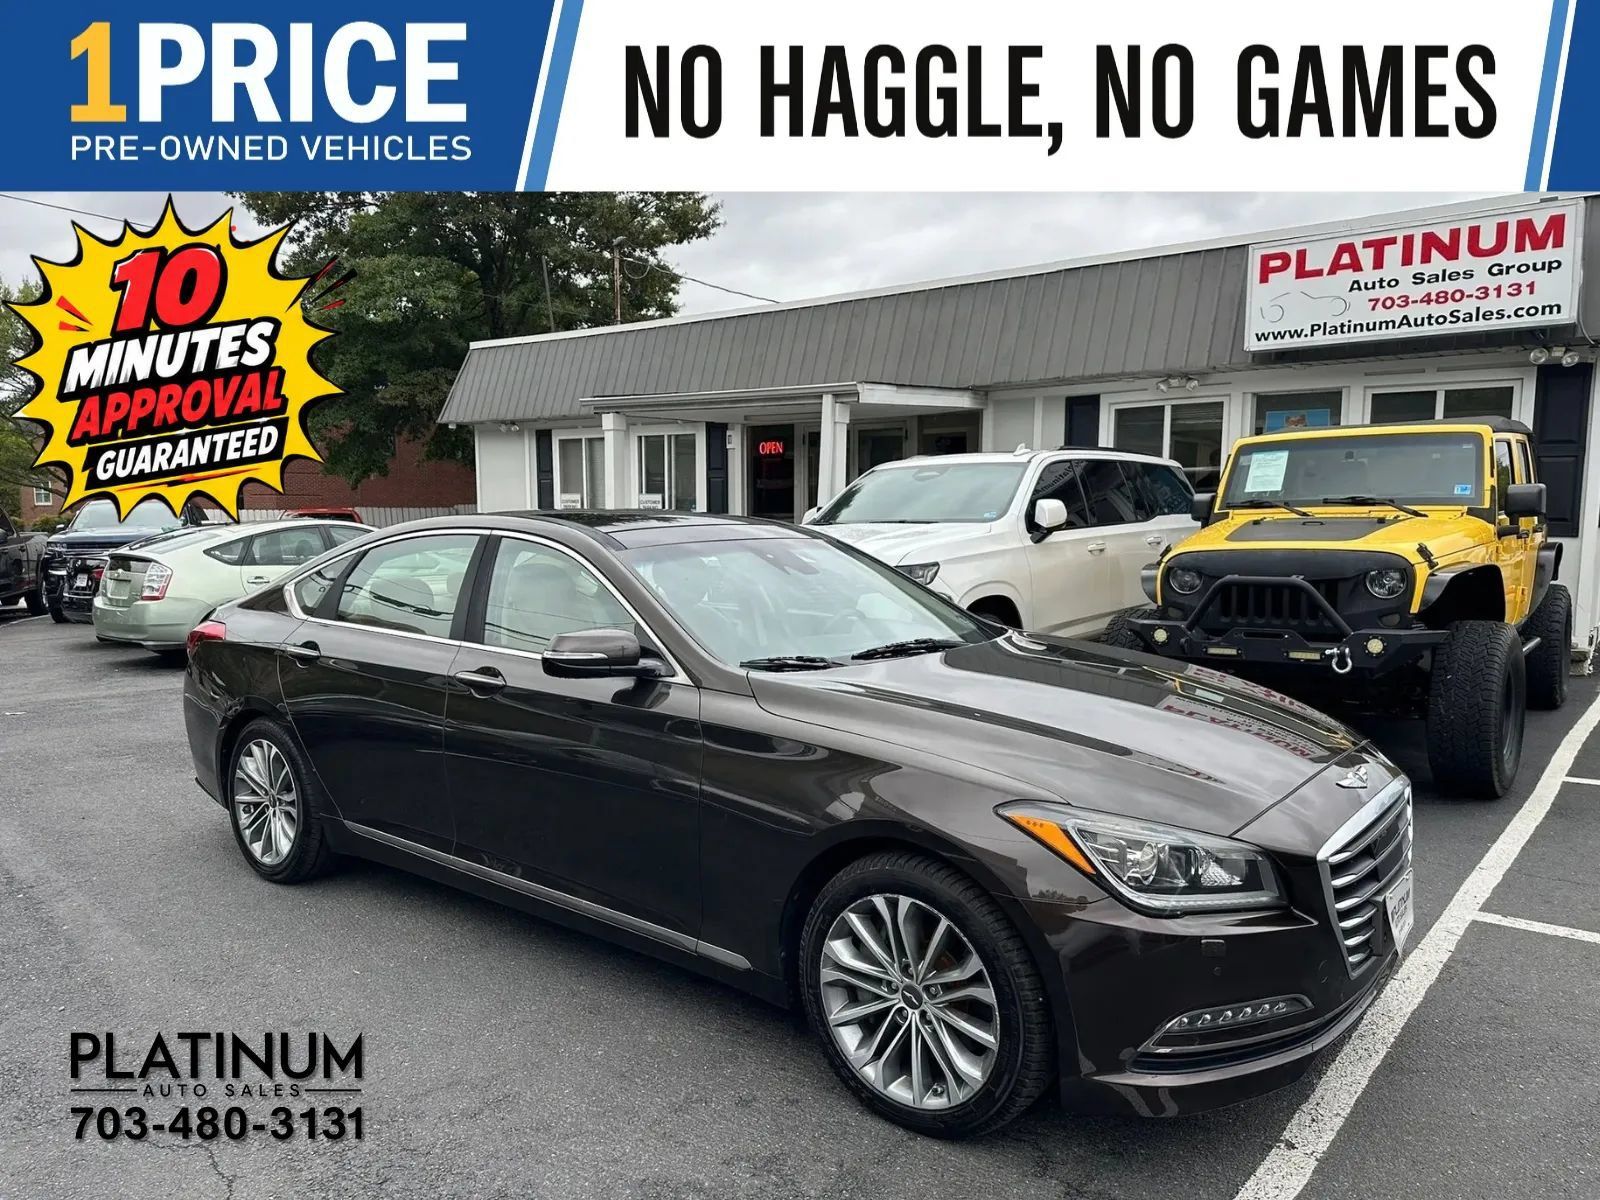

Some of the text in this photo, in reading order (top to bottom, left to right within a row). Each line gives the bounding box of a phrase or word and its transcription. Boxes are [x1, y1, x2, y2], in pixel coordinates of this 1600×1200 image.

[1258, 213, 1566, 284] PLATINUM
[1348, 258, 1562, 293] Auto Sales Group
[1367, 280, 1536, 311] 703-480-3131
[1254, 301, 1562, 342] www.PlatinumAutoSales.com
[759, 441, 784, 455] OPEN
